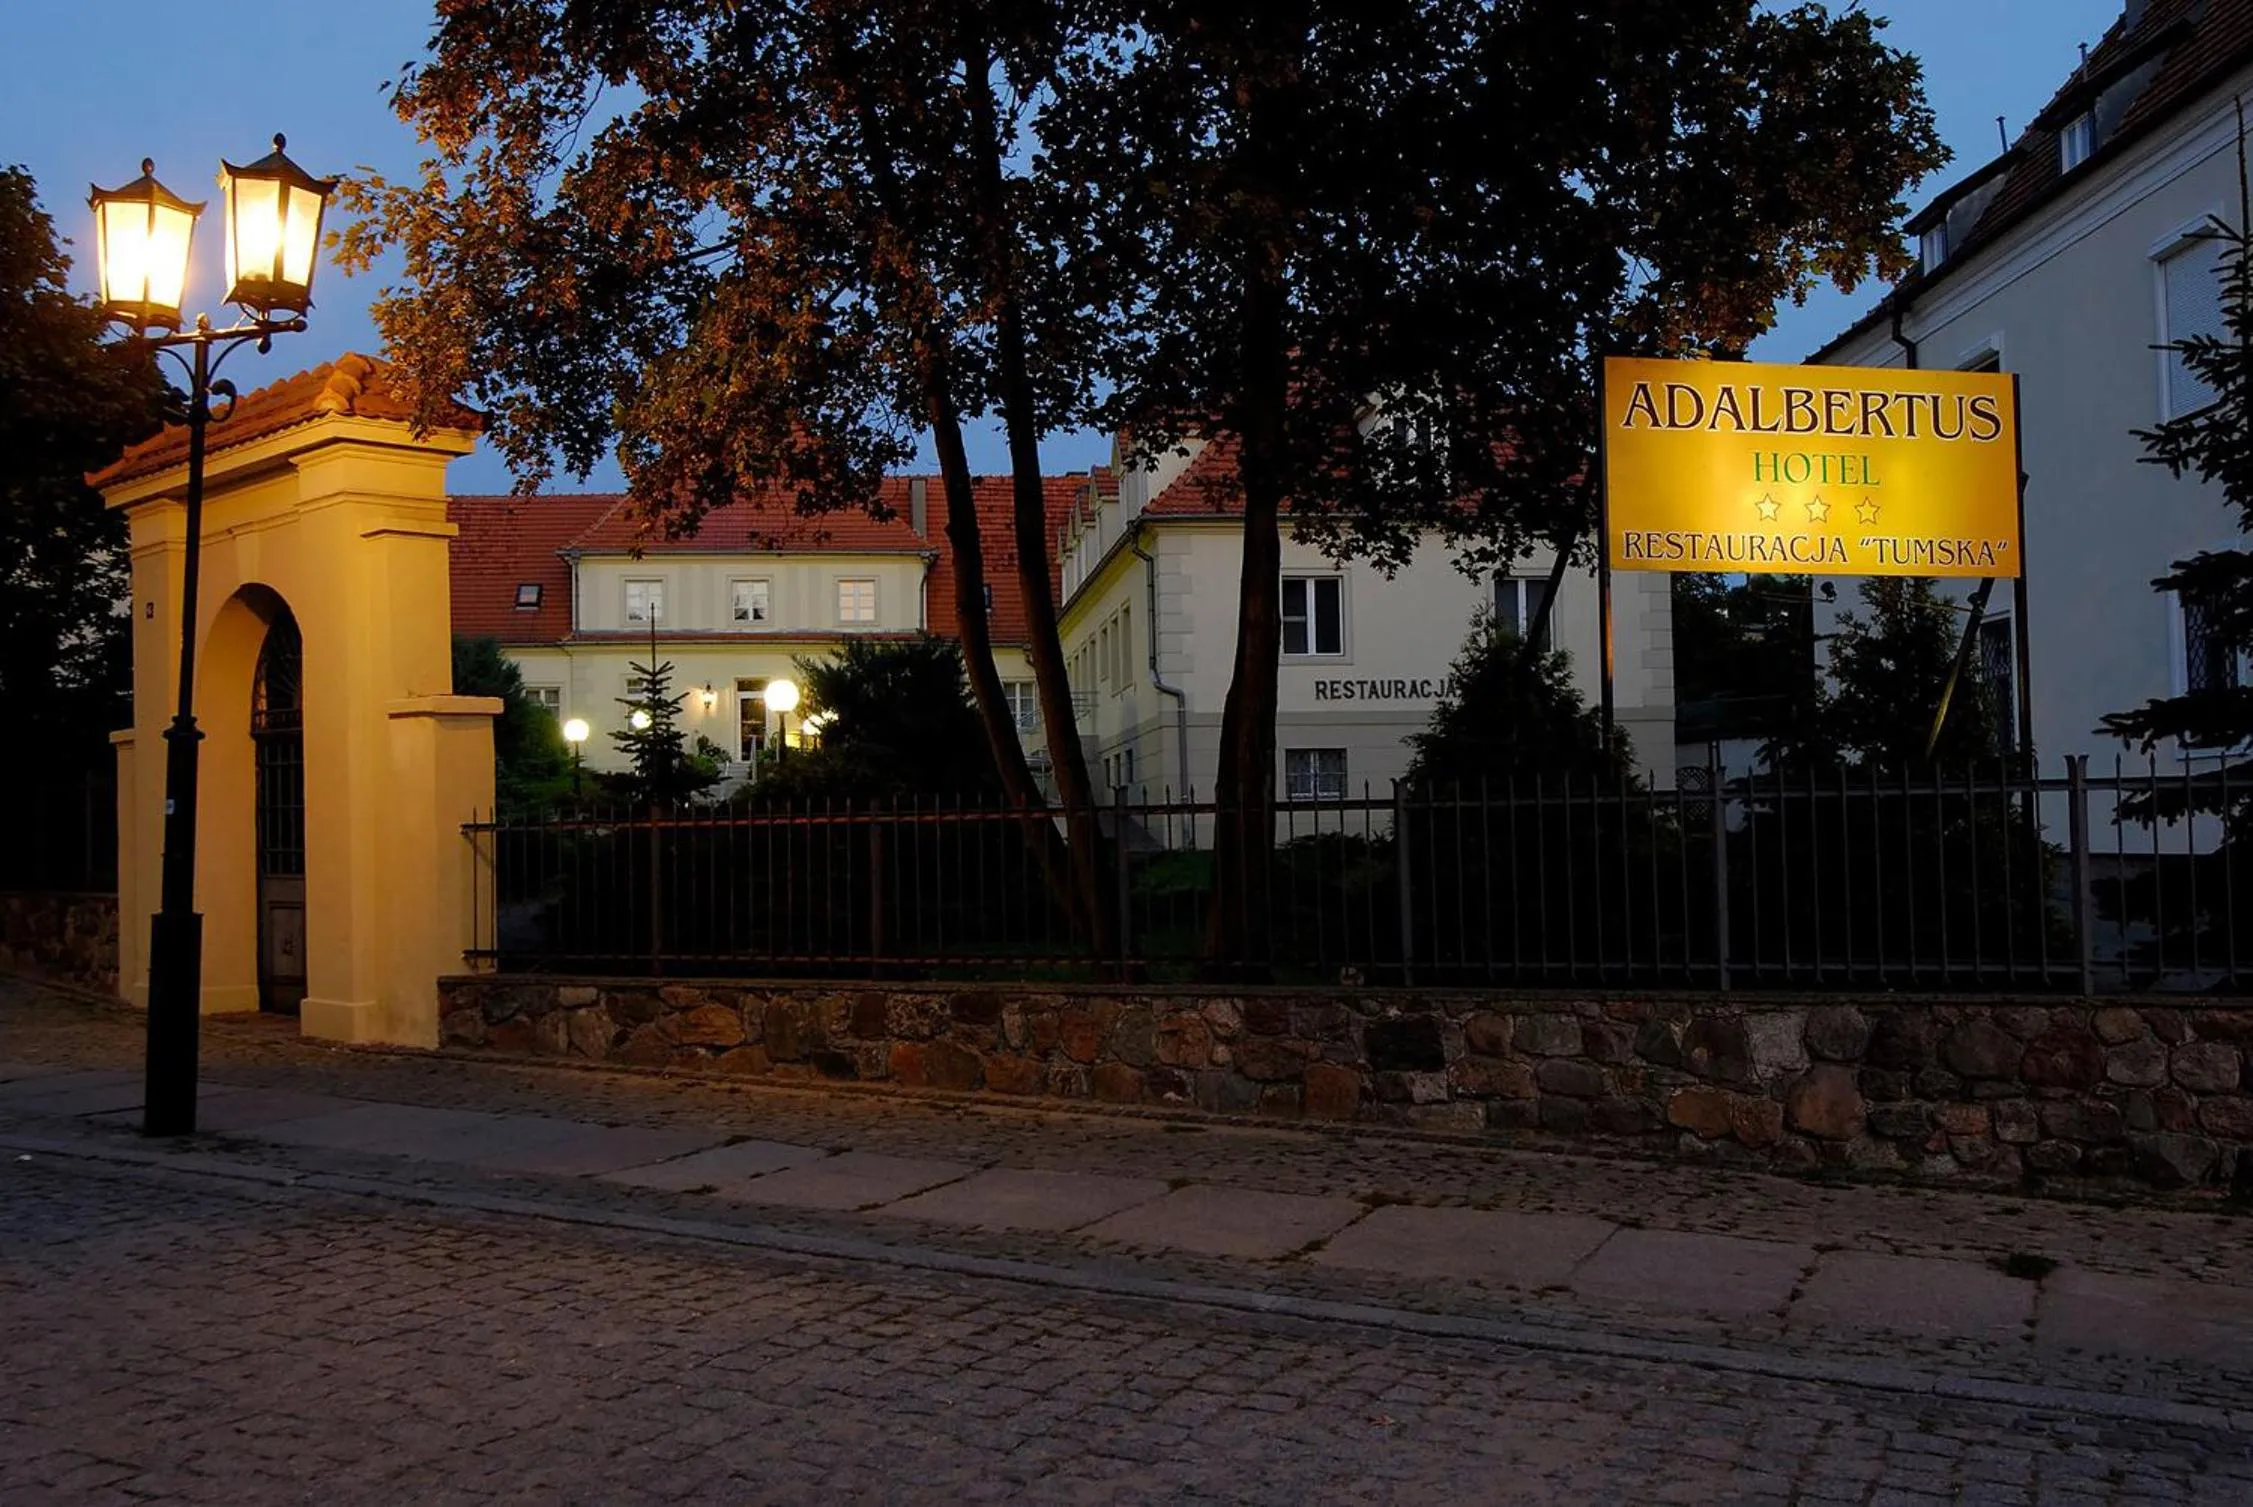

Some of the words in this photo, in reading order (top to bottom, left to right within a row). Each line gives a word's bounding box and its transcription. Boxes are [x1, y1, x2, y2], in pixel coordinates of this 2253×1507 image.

[1623, 381, 2002, 442] ADALBERTUS
[1753, 451, 1881, 486] HOTEL
[1623, 531, 1847, 564] RESTAURACJA
[1860, 538, 2008, 566] "TUMSKA"
